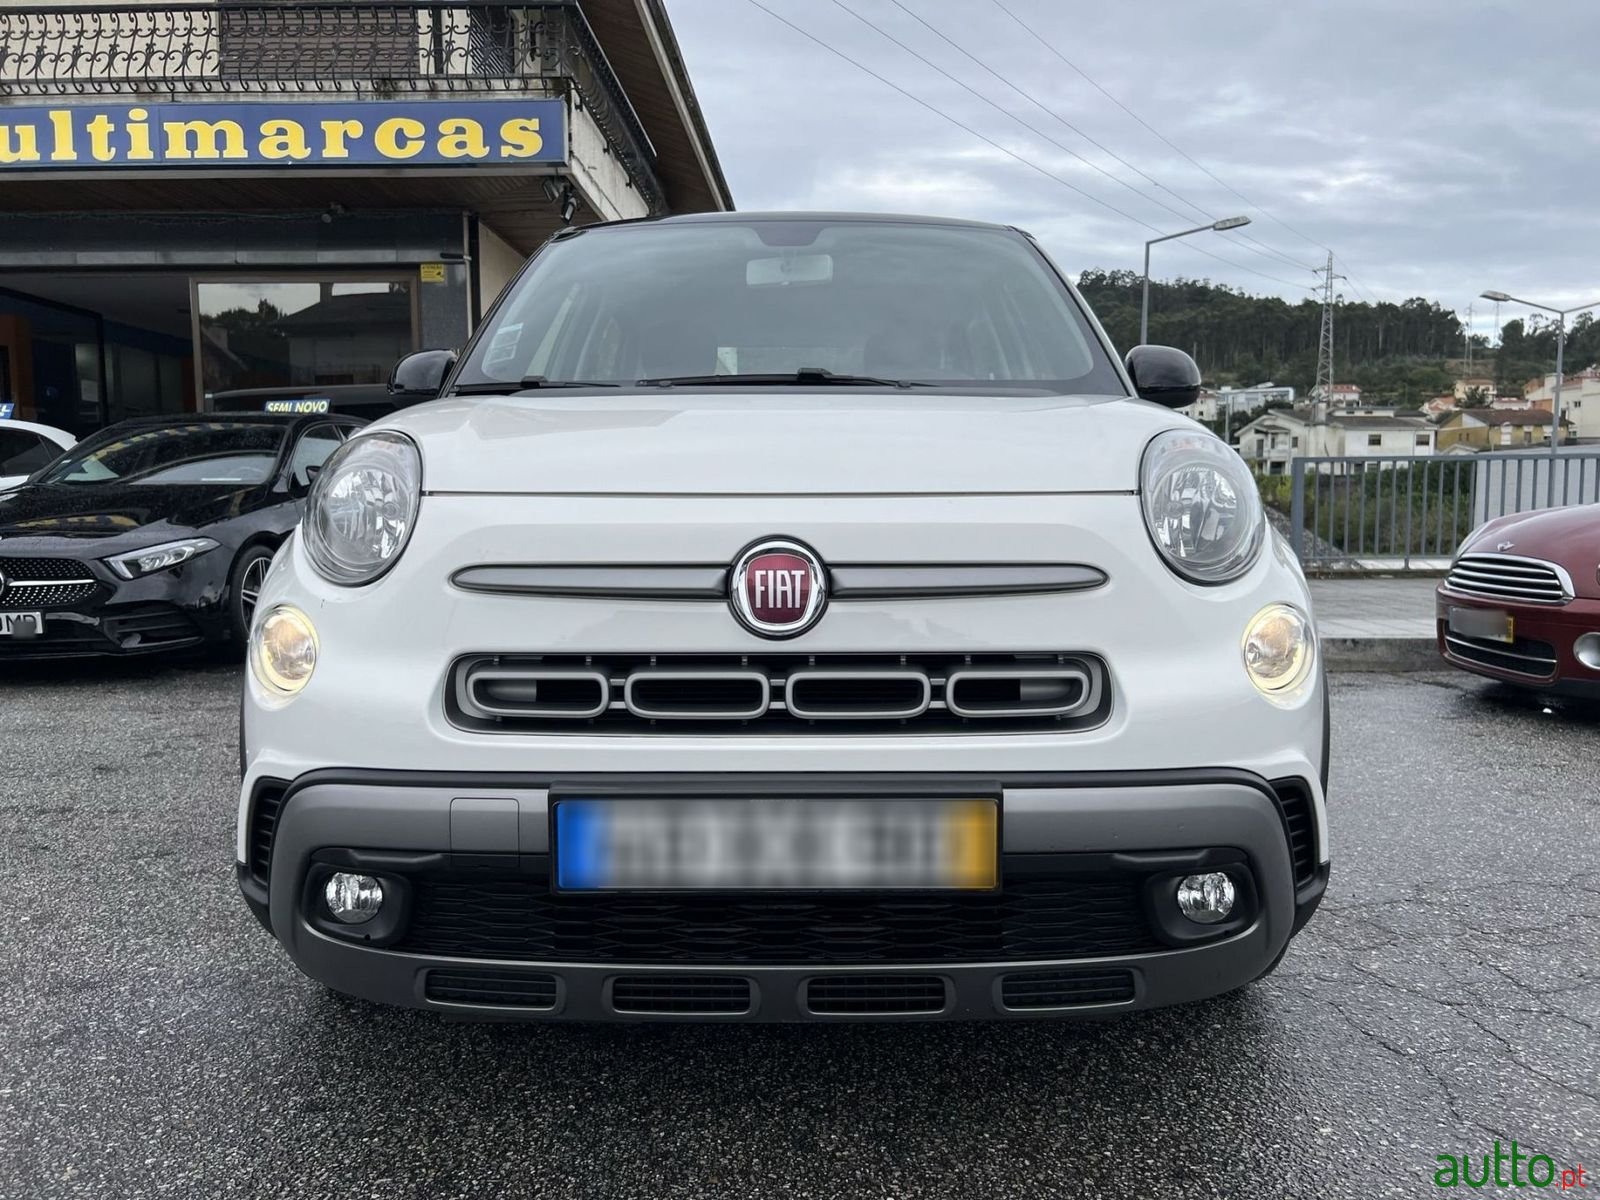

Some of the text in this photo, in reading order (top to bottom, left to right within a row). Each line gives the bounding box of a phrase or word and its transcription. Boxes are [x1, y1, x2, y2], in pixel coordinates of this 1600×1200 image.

[0, 108, 543, 163] ultimarcas
[295, 401, 328, 413] NOVO
[755, 570, 805, 608] FIAT
